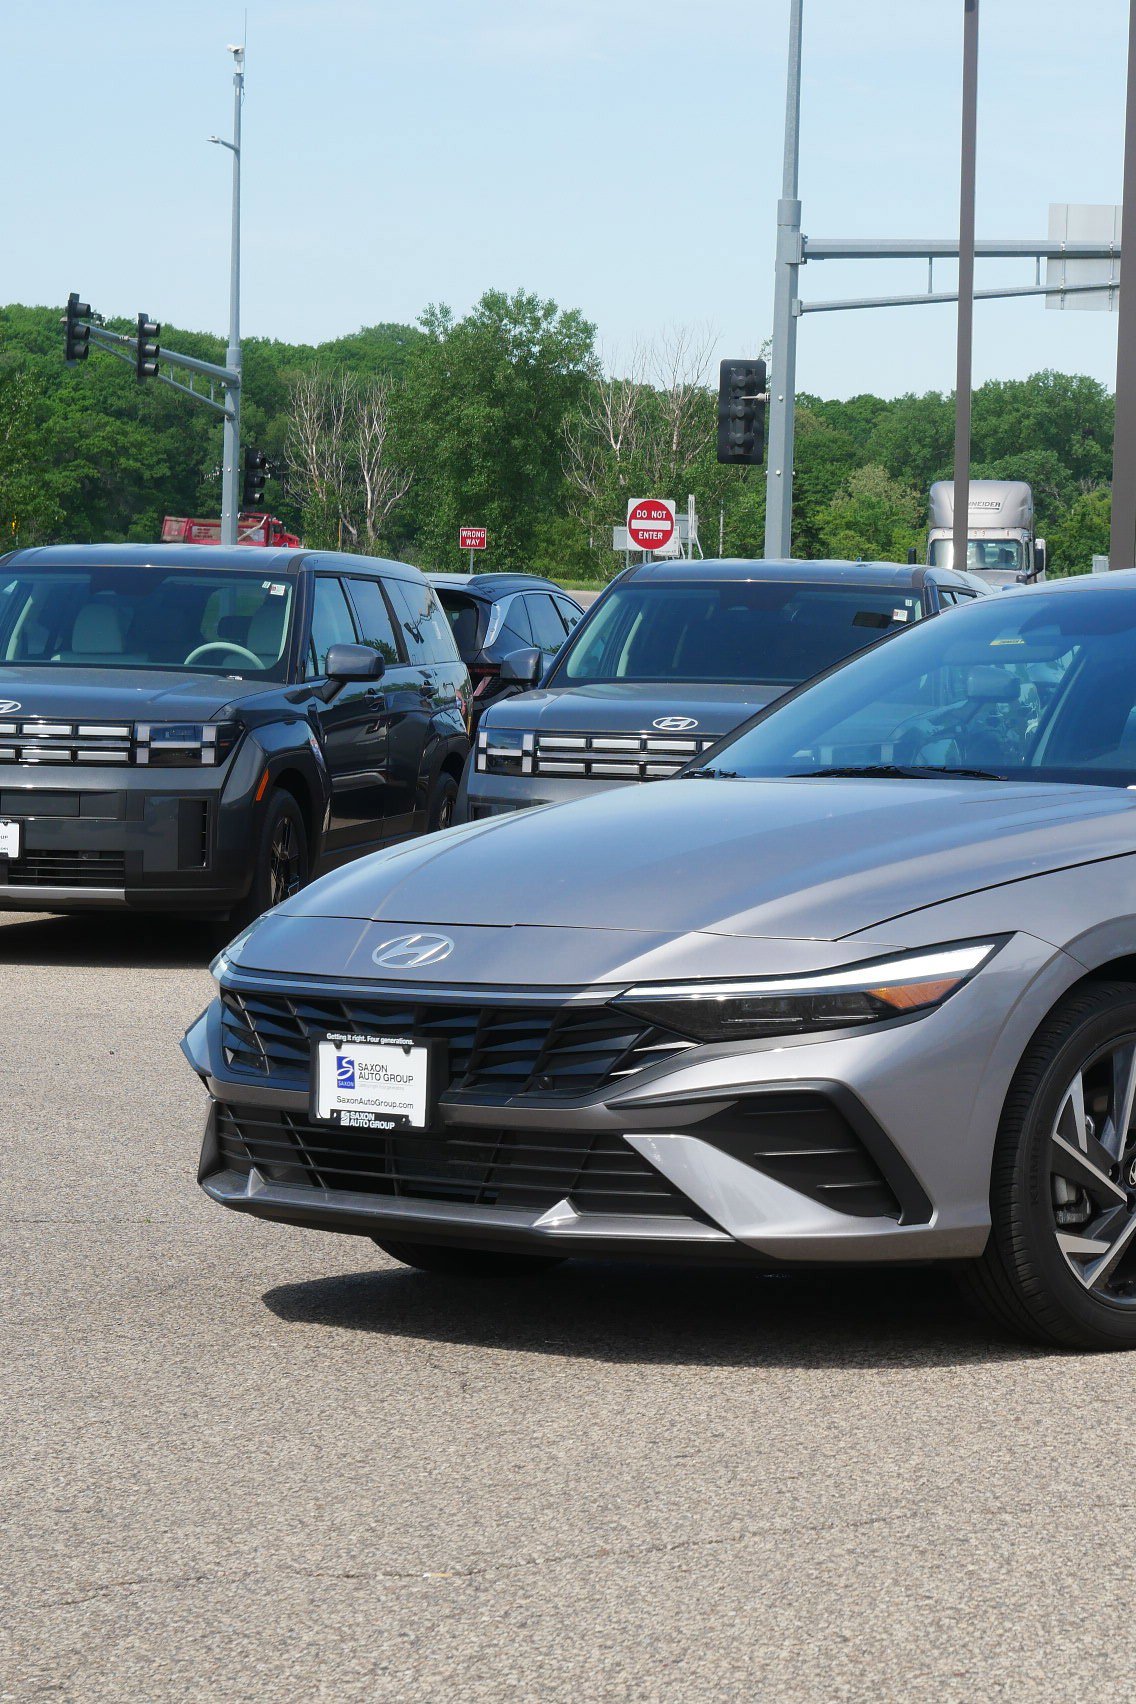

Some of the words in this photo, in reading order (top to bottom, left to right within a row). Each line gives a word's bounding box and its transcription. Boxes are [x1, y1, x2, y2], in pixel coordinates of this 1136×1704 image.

[636, 510, 648, 518] DO
[651, 510, 667, 519] NOT
[461, 530, 485, 538] WRONG
[638, 531, 664, 540] ENTER
[465, 538, 480, 546] WAY
[326, 1032, 347, 1042] Getting
[352, 1034, 366, 1043] right.
[366, 1035, 380, 1043] Four
[380, 1037, 414, 1045] generations.
[357, 1062, 388, 1073] SAXON
[358, 1072, 381, 1081] AUTO
[383, 1073, 414, 1083] GROUP
[336, 1095, 414, 1110] SaxonAutoGroup.com
[350, 1112, 375, 1120] SAXON
[350, 1119, 369, 1127] AUTO
[370, 1121, 395, 1129] GROUP
